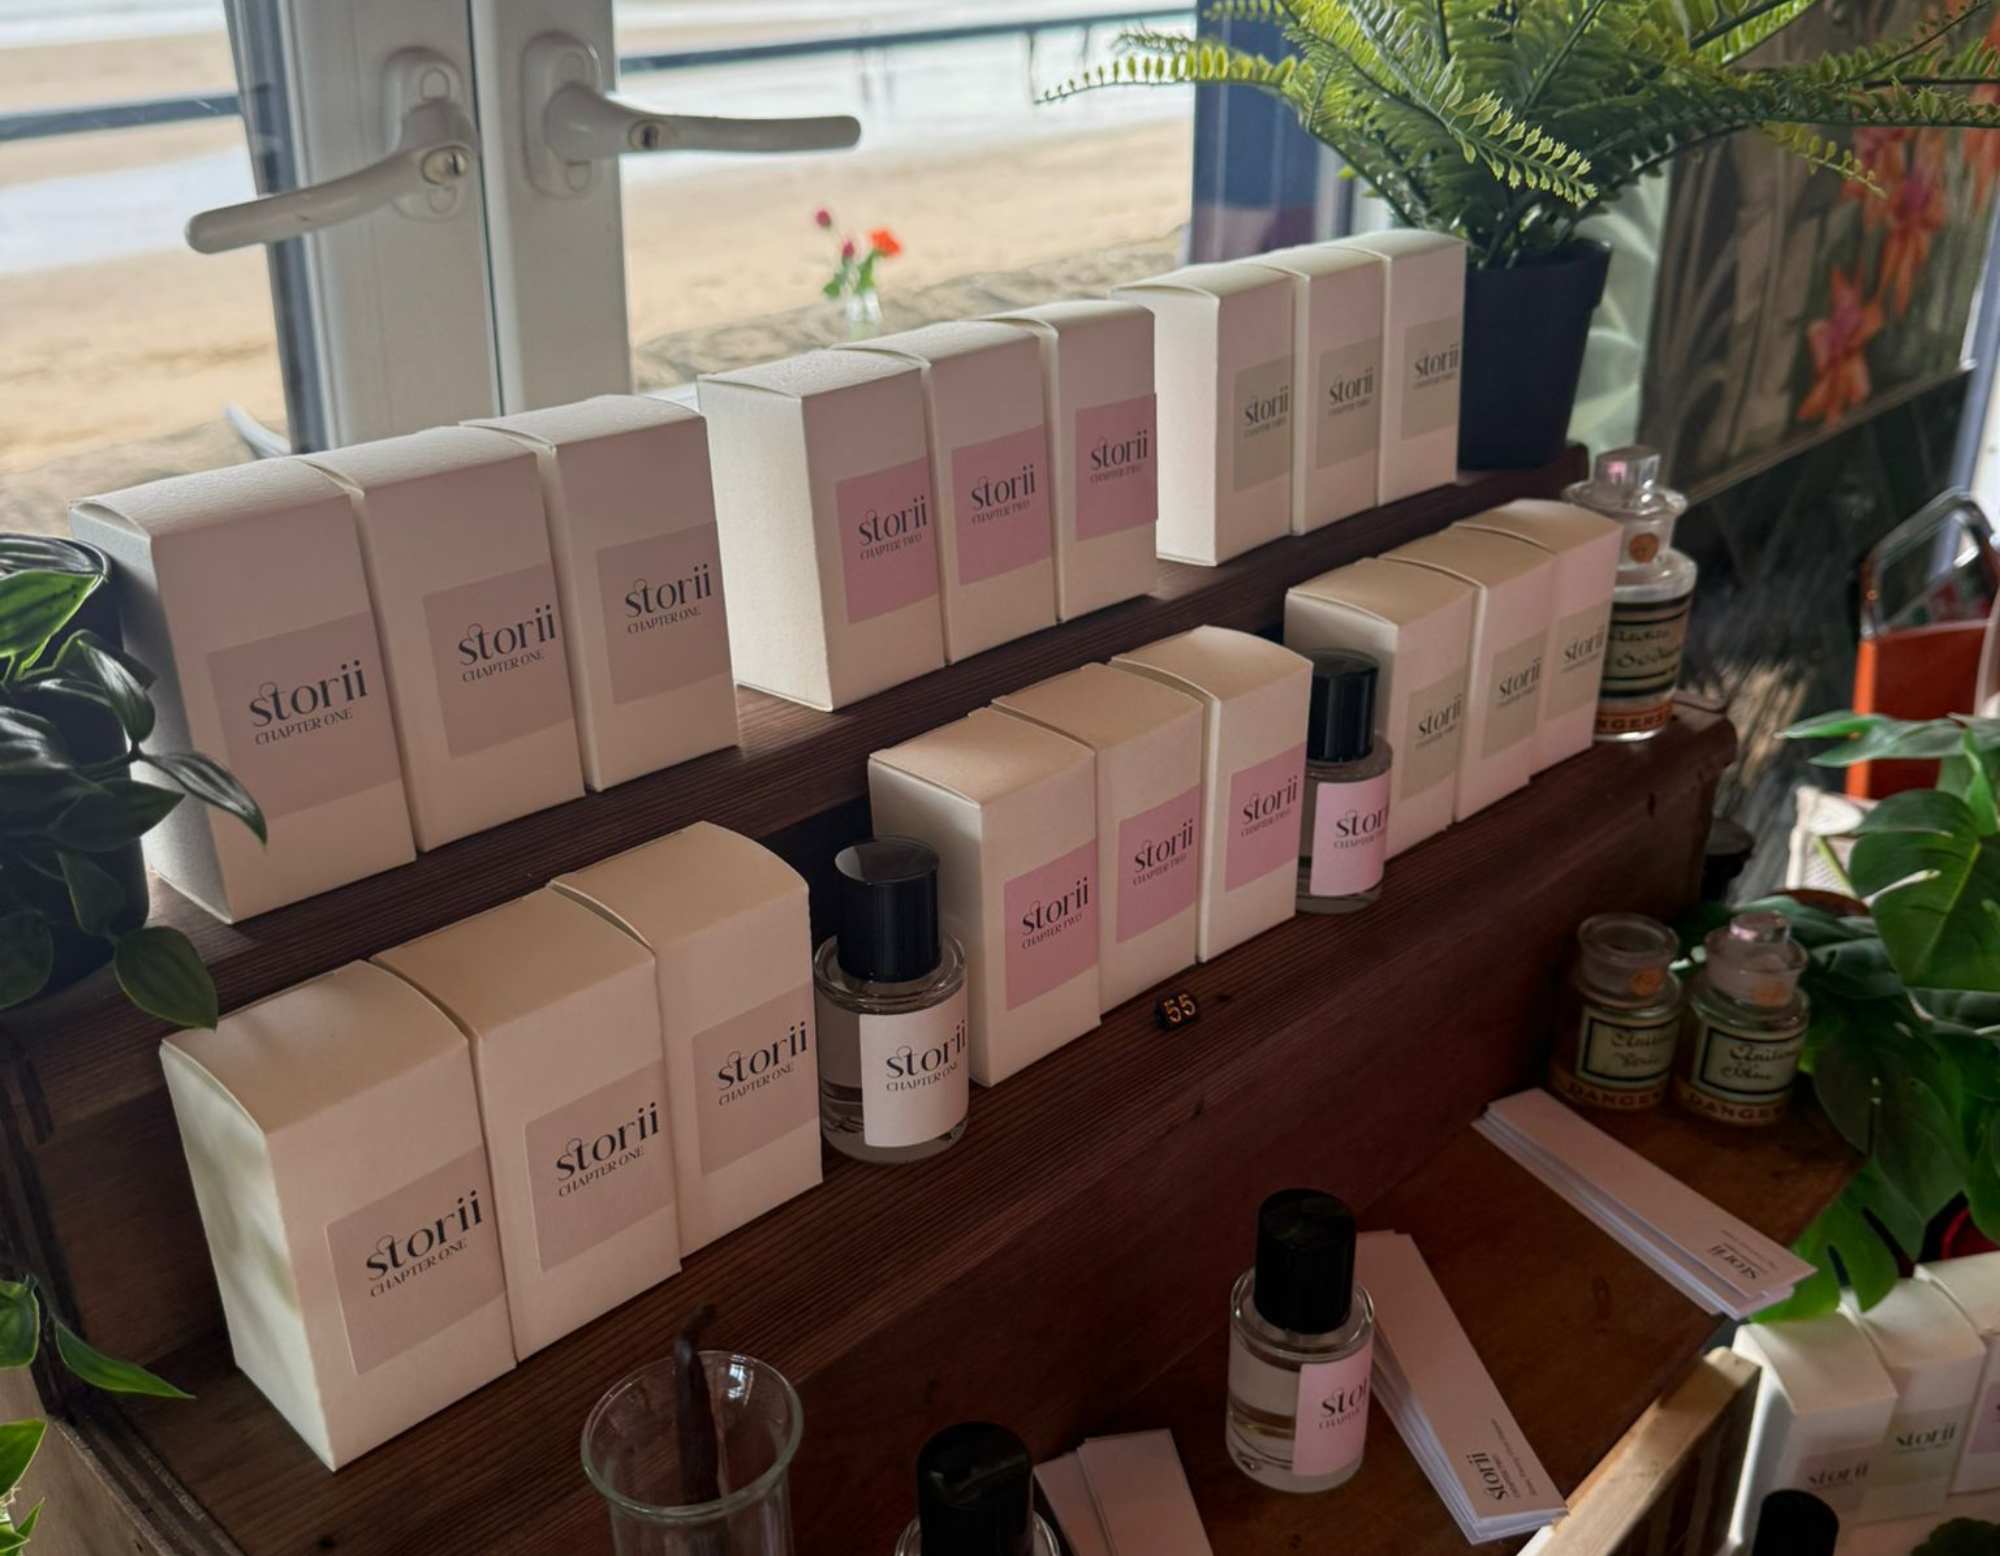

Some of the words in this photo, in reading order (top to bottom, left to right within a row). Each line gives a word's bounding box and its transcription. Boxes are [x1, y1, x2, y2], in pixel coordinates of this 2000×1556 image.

[1414, 343, 1459, 379] storii
[1242, 385, 1289, 427] storii
[1328, 366, 1374, 406] storii
[1089, 429, 1149, 471] storii
[970, 464, 1036, 511] storii
[858, 495, 928, 547] storii
[971, 501, 1010, 525] CHAPTER
[859, 538, 901, 561] CHAPTER
[902, 531, 923, 548] TWO
[624, 563, 712, 619] storii
[457, 603, 556, 667] storii
[626, 613, 678, 635] CHAPTER
[679, 605, 702, 621] ONE
[461, 658, 519, 683] CHAPTER
[520, 649, 544, 667] ONE
[1498, 656, 1542, 698] storii
[248, 659, 369, 728] storii
[254, 717, 321, 746] CHAPTER
[323, 708, 353, 728] ONE
[1417, 693, 1463, 738] storii
[1241, 775, 1298, 825] storii
[1134, 817, 1194, 873] storii
[1240, 814, 1274, 838] CHAPTER
[1132, 860, 1170, 887] CHAPTER
[1021, 876, 1089, 936] storii
[1021, 924, 1064, 950] CHAPTER
[1065, 912, 1083, 931] TWO
[1163, 992, 1198, 1025] 55
[717, 1020, 808, 1091] storii
[885, 1018, 966, 1079] storii
[718, 1079, 767, 1107] CHAPTER
[768, 1065, 795, 1085] ONE
[886, 1073, 938, 1092] CHAPTER
[939, 1061, 959, 1081] ONE
[555, 1101, 660, 1182] storii
[557, 1161, 617, 1198] CHAPTER
[618, 1146, 645, 1170] ONE
[365, 1188, 483, 1281] storii
[369, 1253, 437, 1298] CHAPTER
[437, 1237, 468, 1263] ONE
[1465, 1452, 1510, 1500] storii
